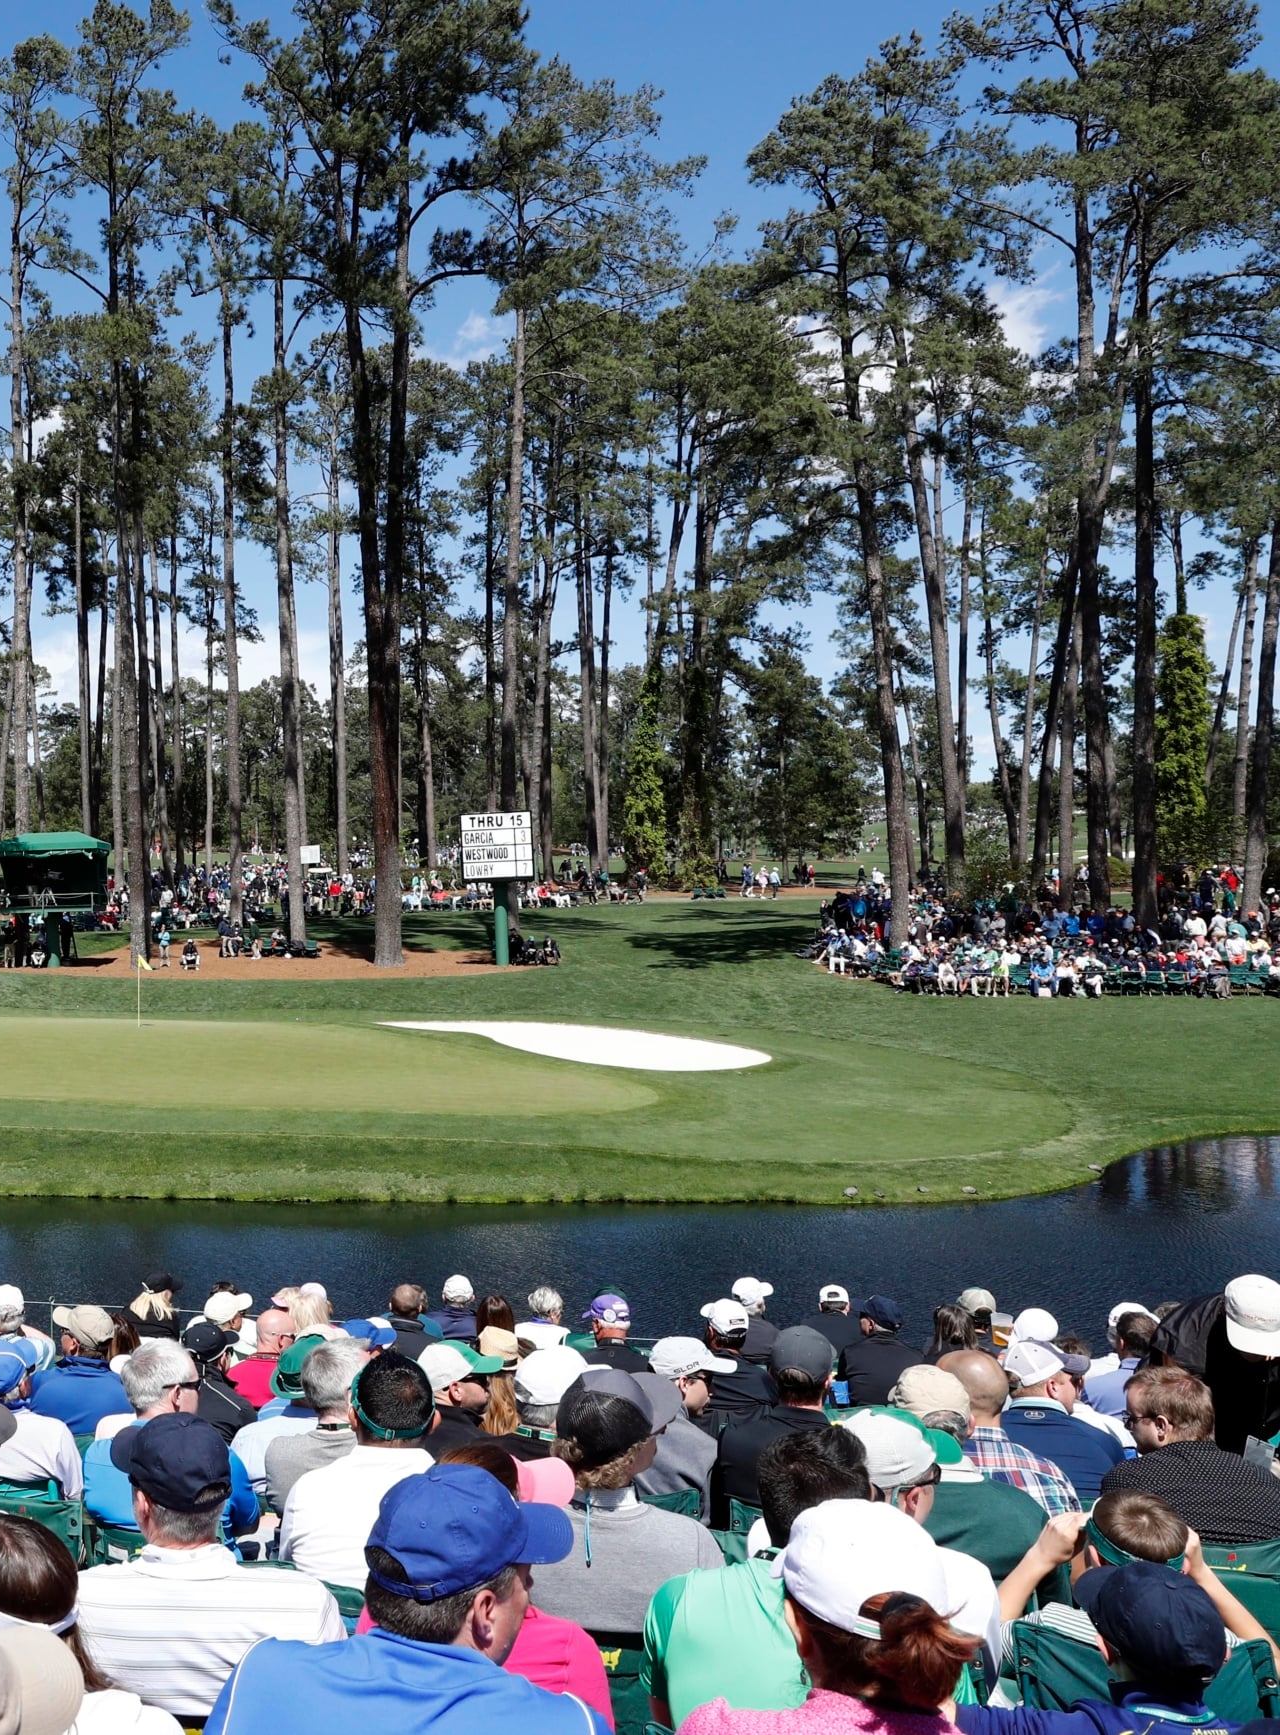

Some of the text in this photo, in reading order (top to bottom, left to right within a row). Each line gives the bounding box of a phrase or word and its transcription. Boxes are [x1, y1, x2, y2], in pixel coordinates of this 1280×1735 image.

[469, 815, 523, 828] THRU 15
[464, 830, 526, 845] GARCIA 3
[464, 847, 508, 860] WESTWOOD
[465, 863, 528, 877] LOWRY 7
[673, 1361, 700, 1374] SLDR
